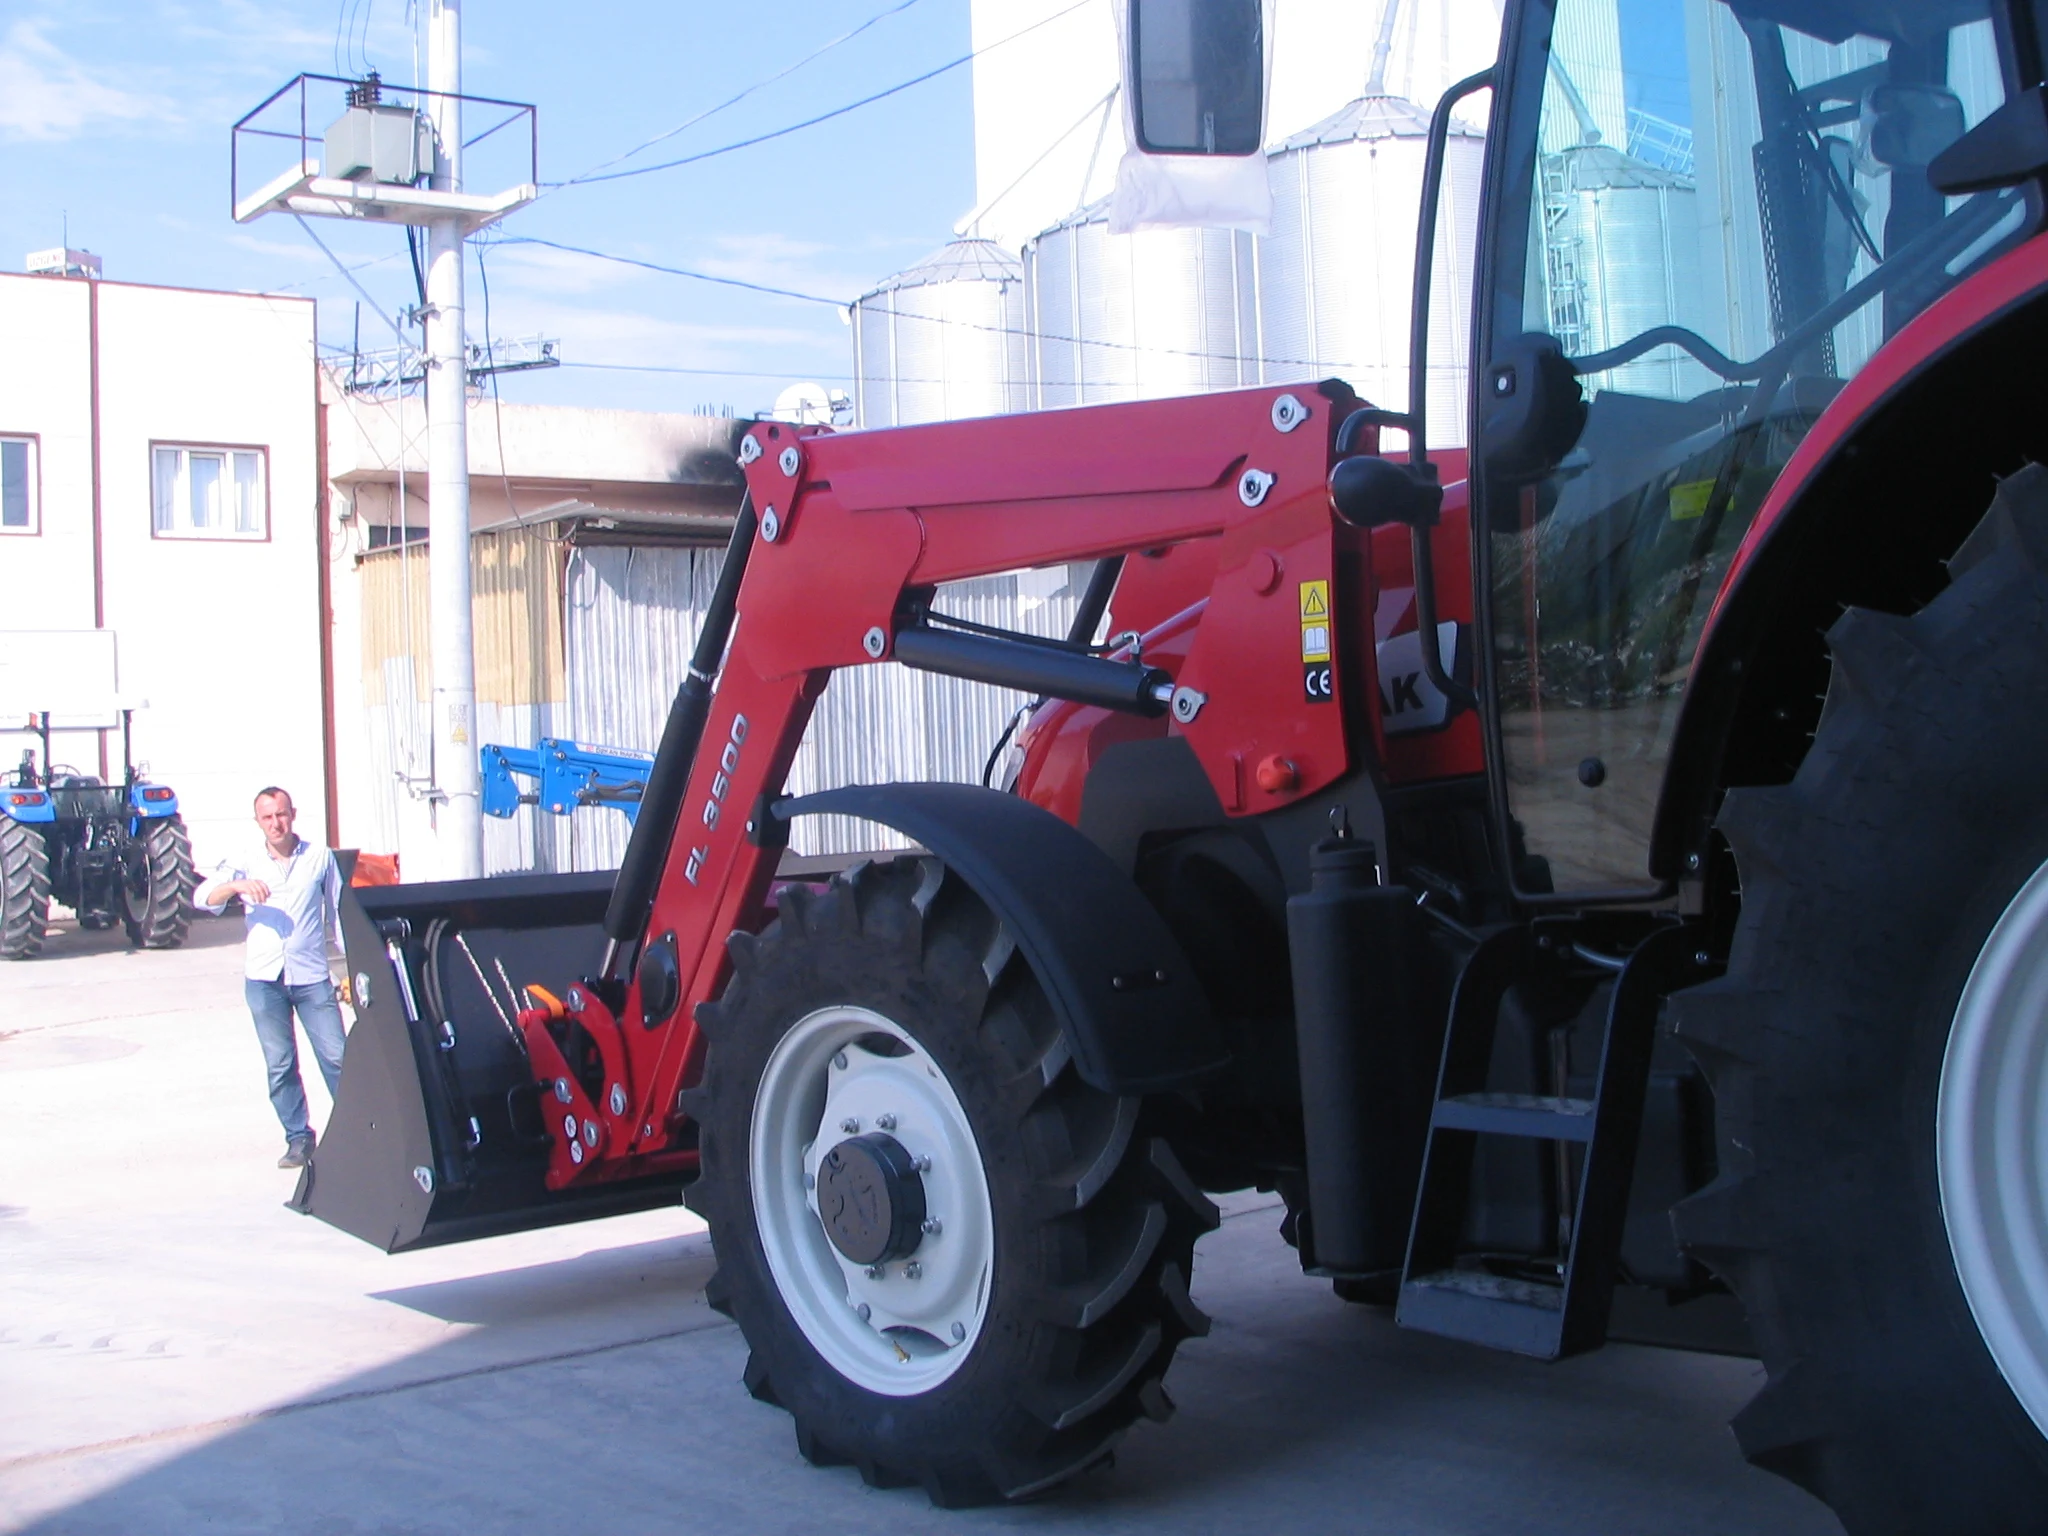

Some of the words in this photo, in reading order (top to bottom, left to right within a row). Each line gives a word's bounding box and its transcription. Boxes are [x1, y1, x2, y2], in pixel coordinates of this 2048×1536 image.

[1305, 668, 1331, 696] CE
[684, 844, 710, 887] FL
[702, 712, 749, 832] 3500
